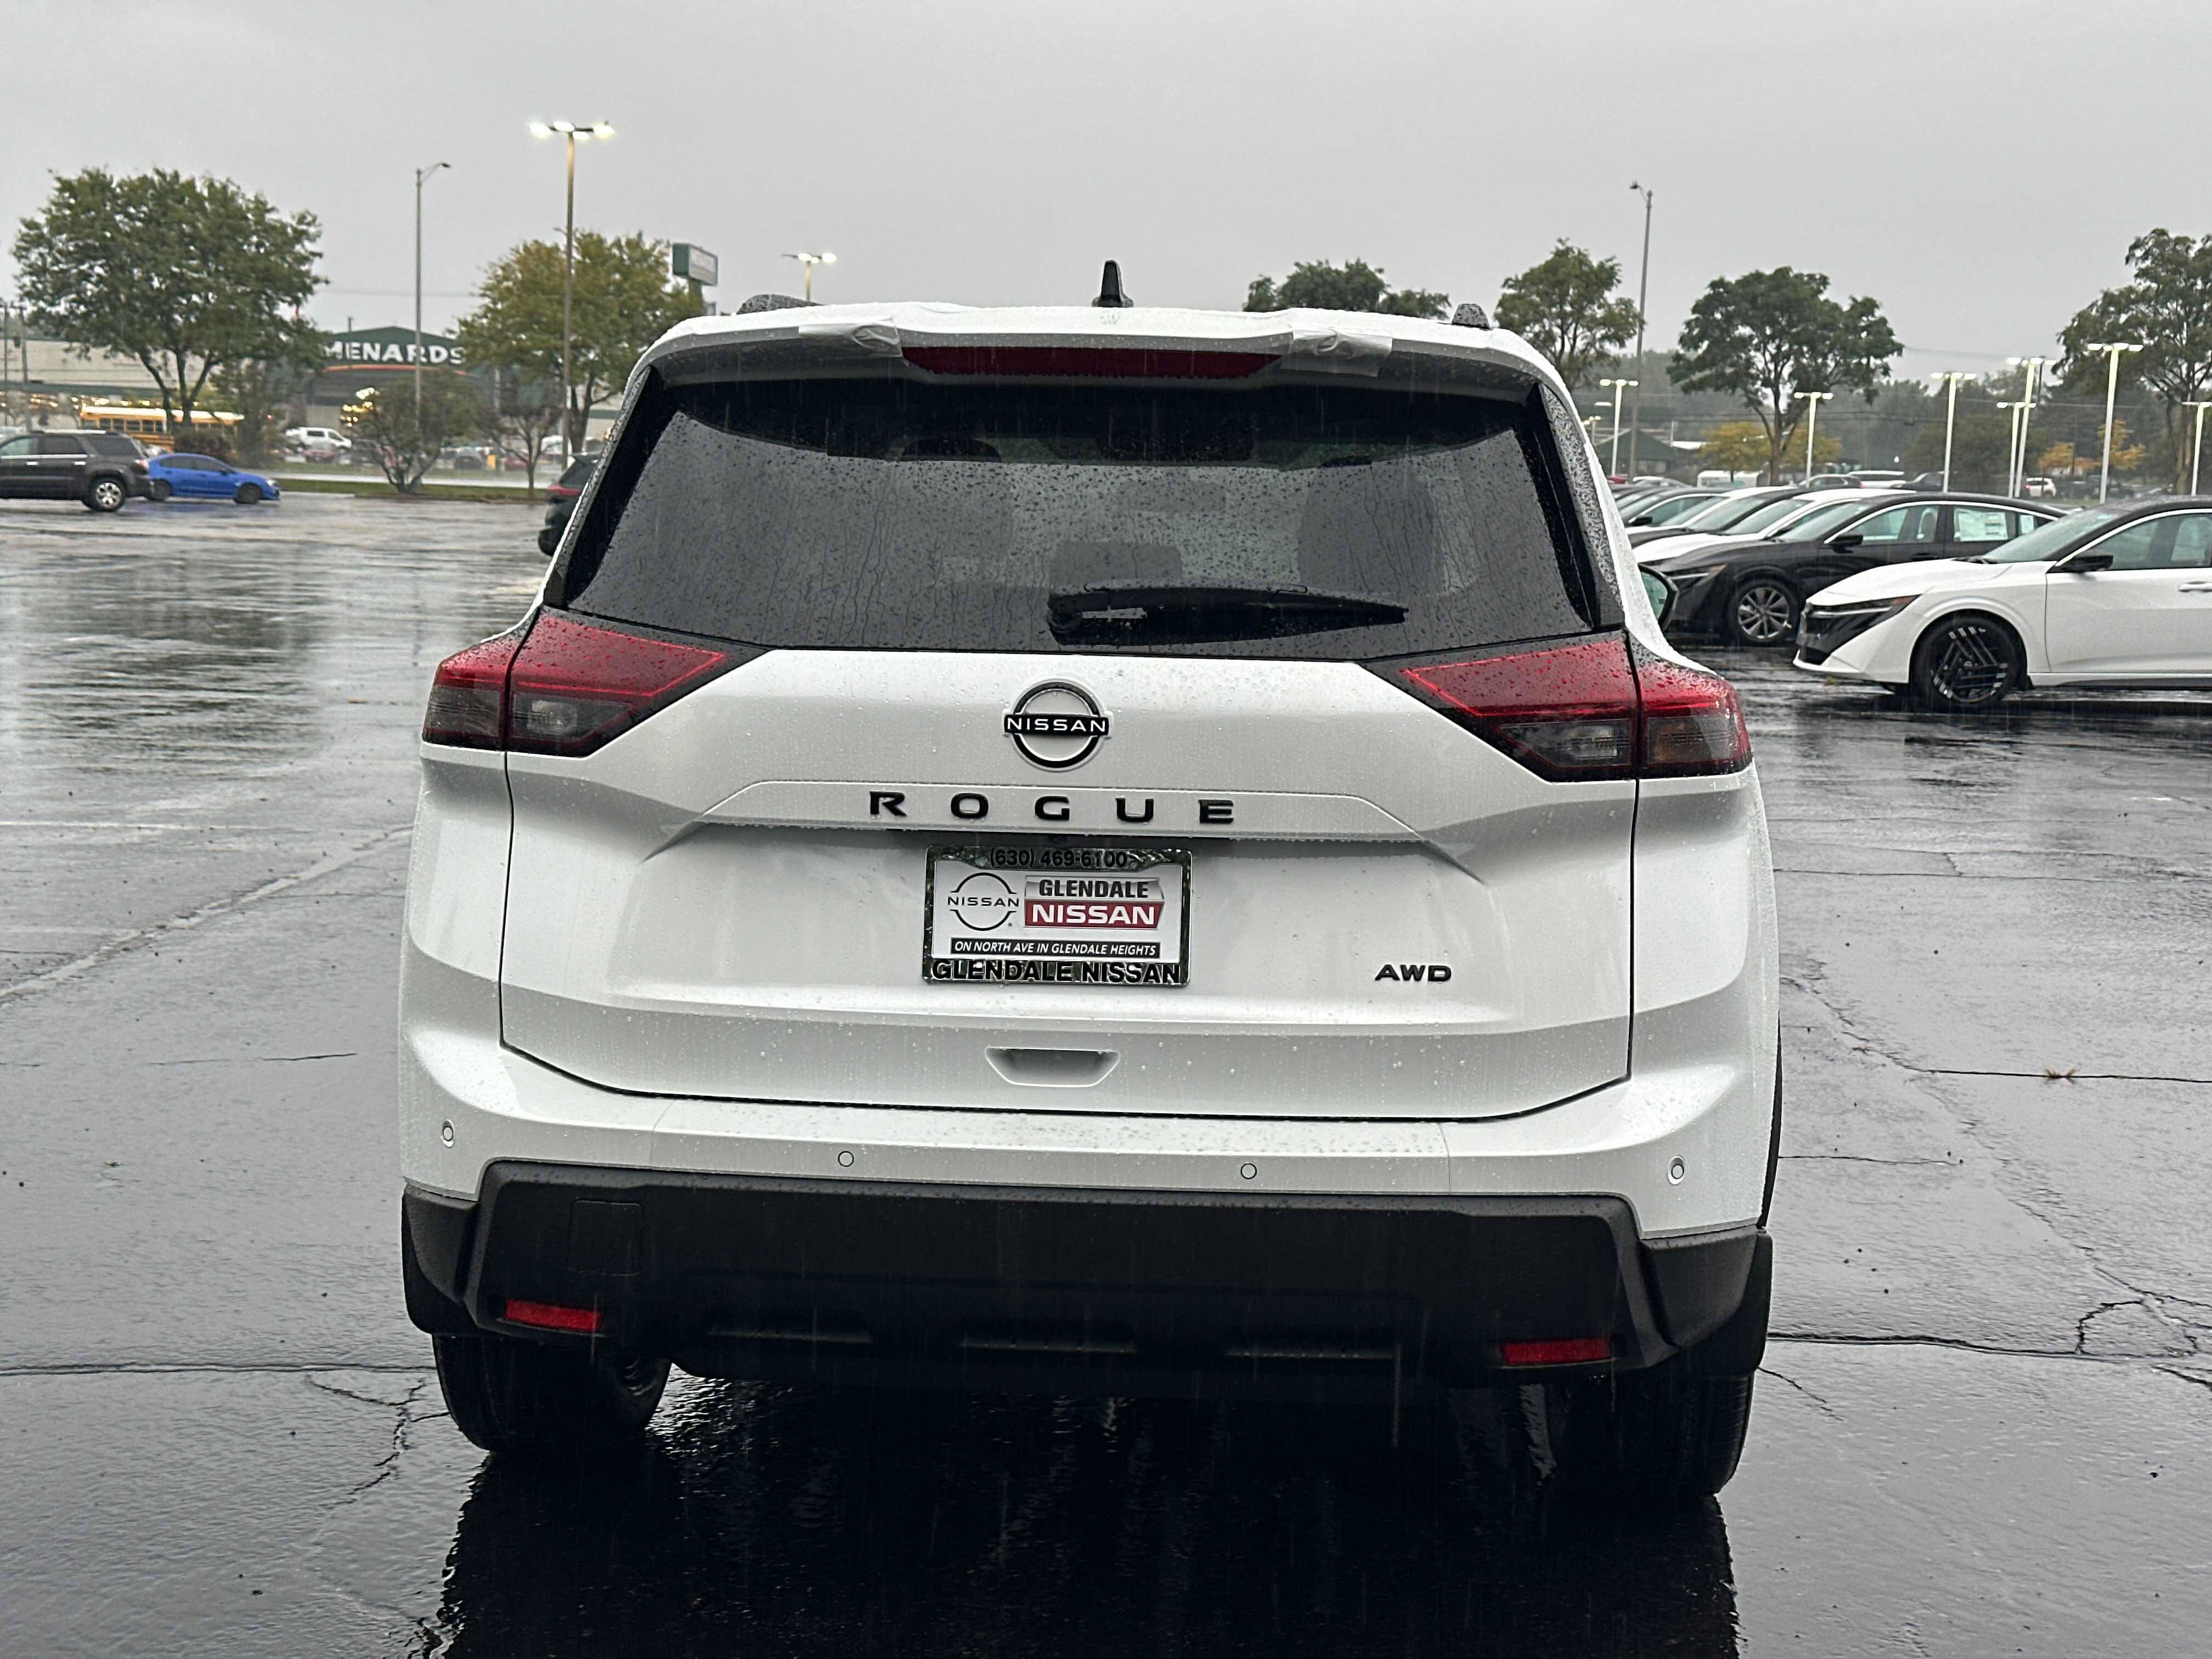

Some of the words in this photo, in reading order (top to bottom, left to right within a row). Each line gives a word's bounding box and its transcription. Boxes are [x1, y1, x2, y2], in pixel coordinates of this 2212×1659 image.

[325, 341, 466, 365] MENARDS
[1007, 718, 1105, 732] NISSAN
[869, 791, 1234, 823] ROGUE
[990, 849, 1034, 867] (630)
[1041, 850, 1127, 868] 469-6100
[1039, 879, 1148, 898] GLENDALE
[947, 896, 1019, 907] NISSAN
[1032, 904, 1154, 925] NISSAN
[955, 941, 972, 952] ON
[973, 941, 1012, 953] NORTH
[1013, 943, 1034, 953] AVE
[1036, 943, 1048, 953] IN
[1052, 944, 1107, 955] GLENDALE
[1110, 945, 1156, 955] HEIGHTS
[932, 960, 1073, 981] GLENDALE
[1082, 962, 1180, 983] NISSAN
[1375, 964, 1451, 981] AWD
